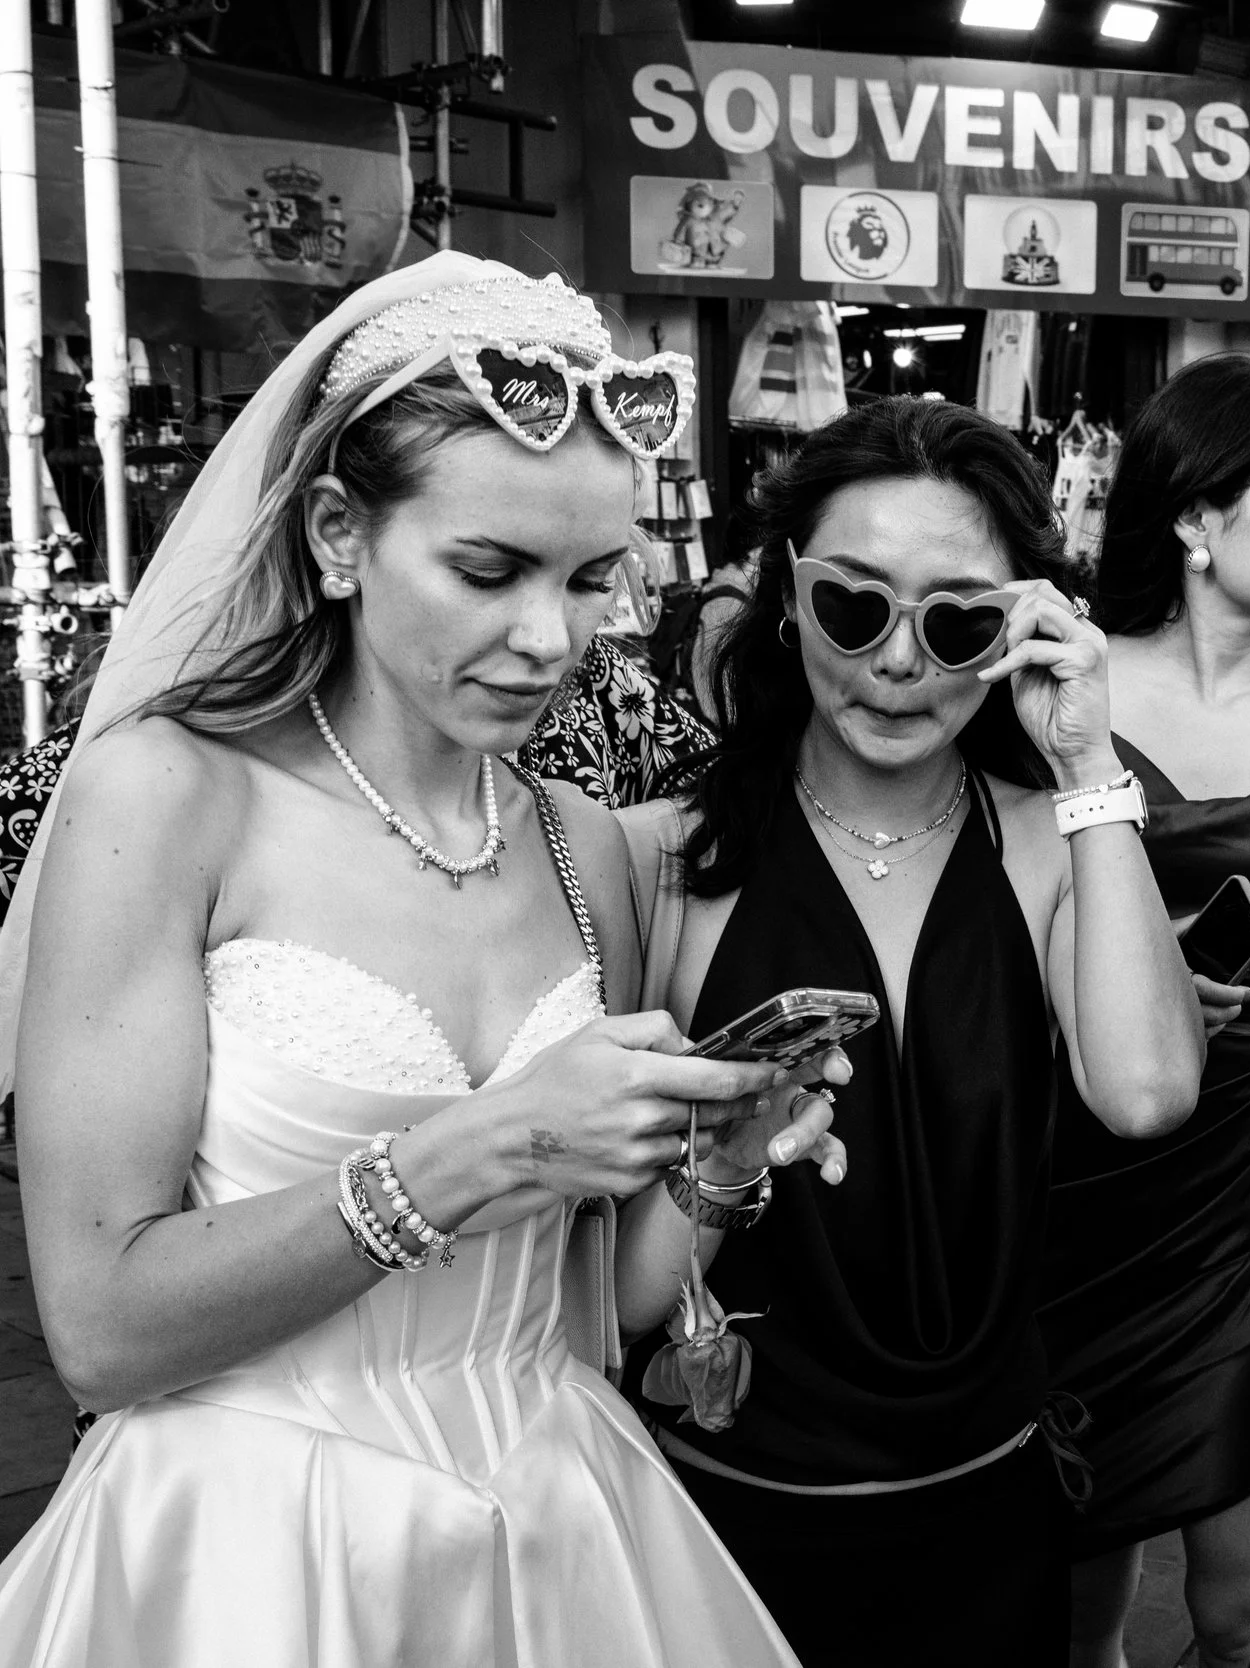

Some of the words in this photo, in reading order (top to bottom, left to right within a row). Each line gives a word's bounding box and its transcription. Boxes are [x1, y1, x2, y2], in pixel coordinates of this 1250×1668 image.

[630, 63, 1250, 182] SOUVENIRS
[502, 378, 549, 409] Mrs
[613, 391, 675, 427] Kempf
